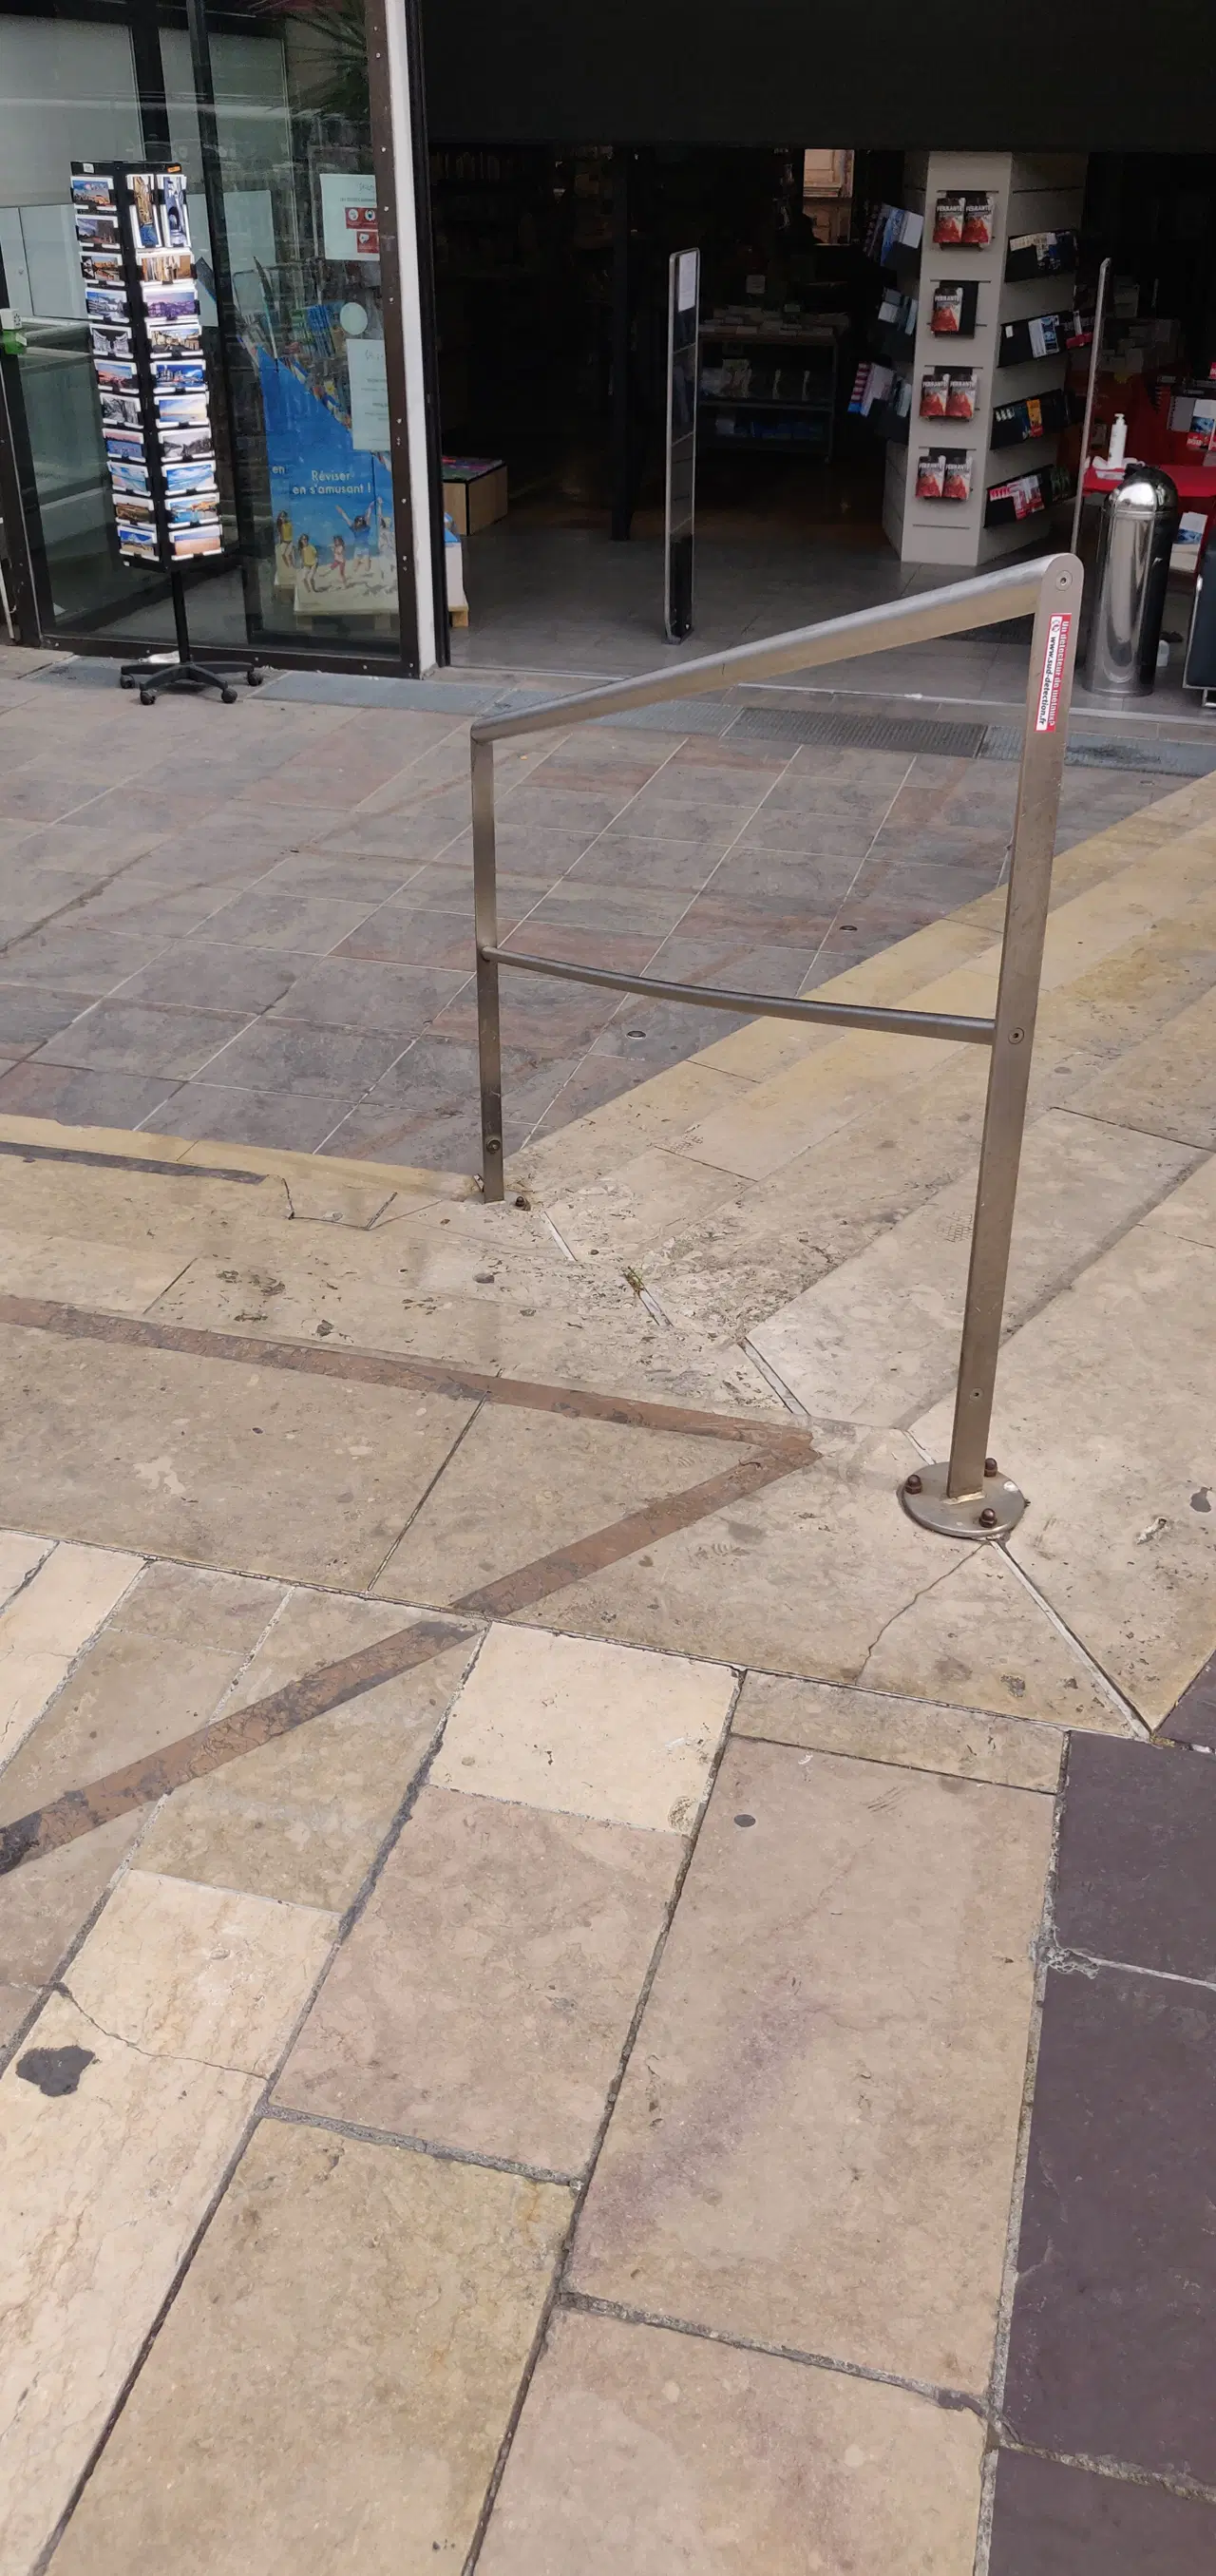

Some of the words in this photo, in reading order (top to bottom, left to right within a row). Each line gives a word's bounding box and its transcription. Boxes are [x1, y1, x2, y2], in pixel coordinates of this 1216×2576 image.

[272, 466, 285, 474] en
[311, 469, 352, 482] Réviser
[292, 486, 307, 495] en
[310, 483, 364, 495] s'amusant
[1061, 620, 1070, 633] Un
[1038, 637, 1056, 725] www.sud-detection.fr
[1053, 677, 1062, 688] de
